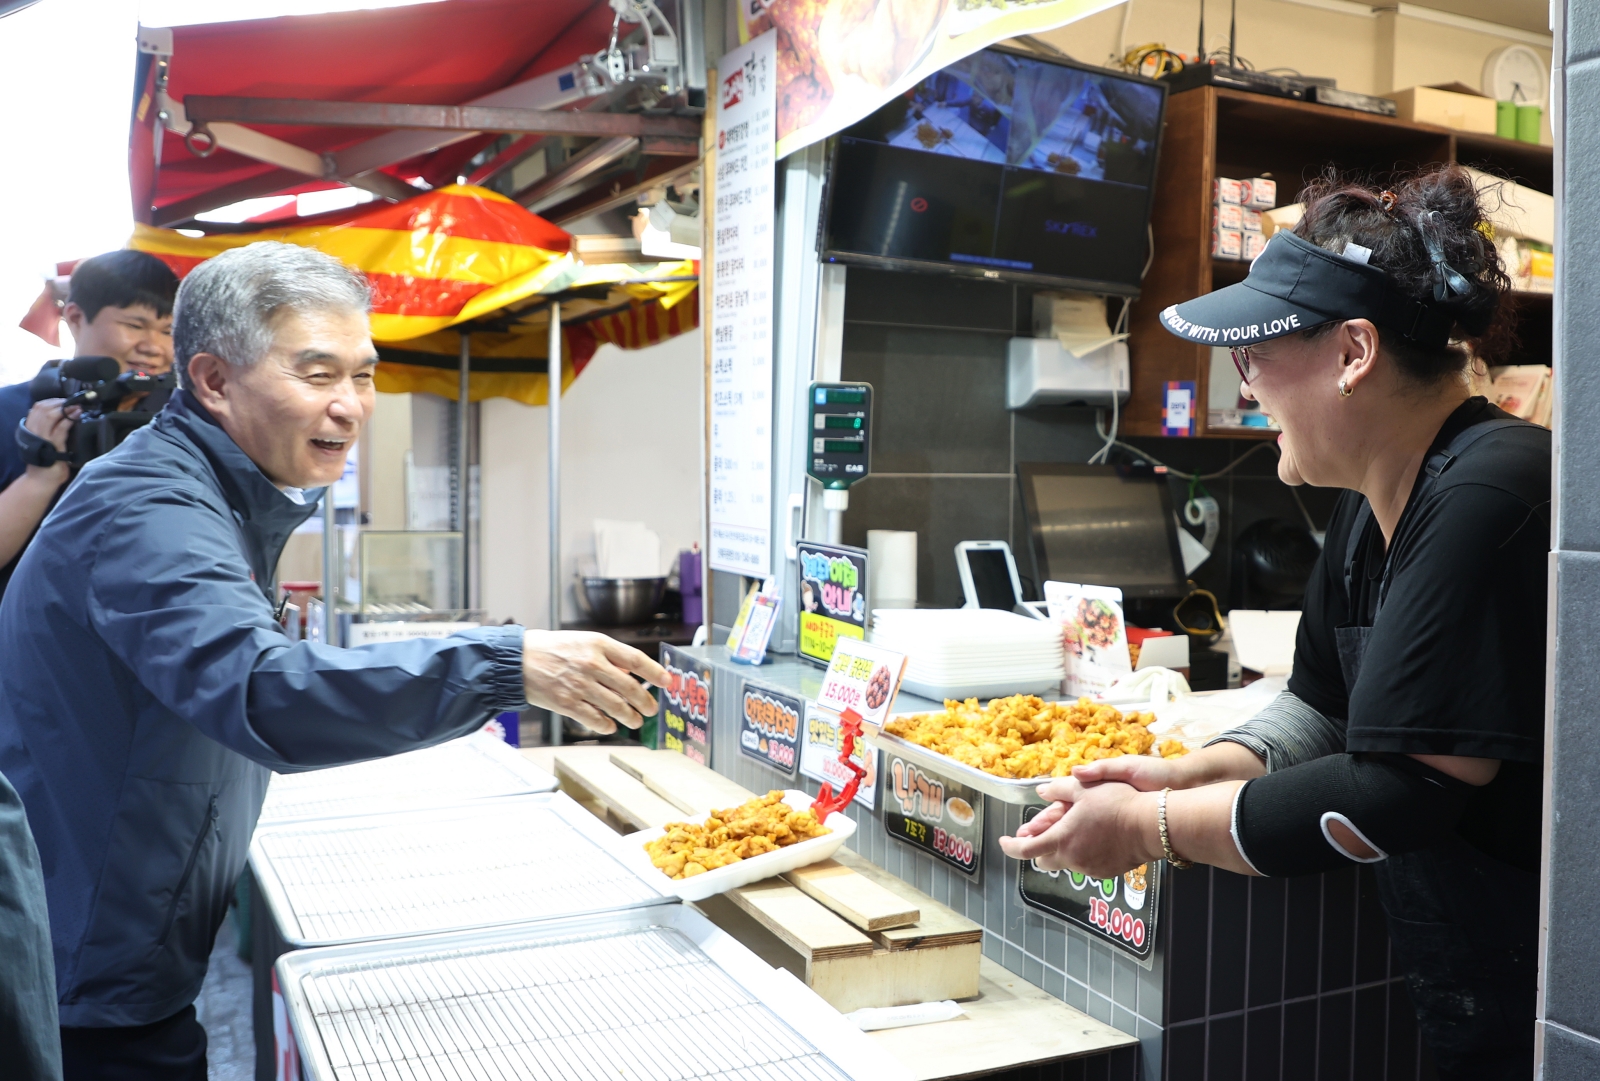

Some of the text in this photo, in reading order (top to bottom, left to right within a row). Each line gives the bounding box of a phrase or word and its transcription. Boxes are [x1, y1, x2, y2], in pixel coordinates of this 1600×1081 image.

[1167, 313, 1301, 342] GOLF WITH YOUR LOVE
[802, 552, 857, 589] 계좌 이체
[822, 583, 851, 613] 안내
[848, 656, 875, 682] 닭강정
[808, 719, 835, 747] 맛있는
[892, 758, 944, 822] 날개
[904, 818, 973, 865] 7조각 13,000
[1089, 896, 1145, 947] 15,000
